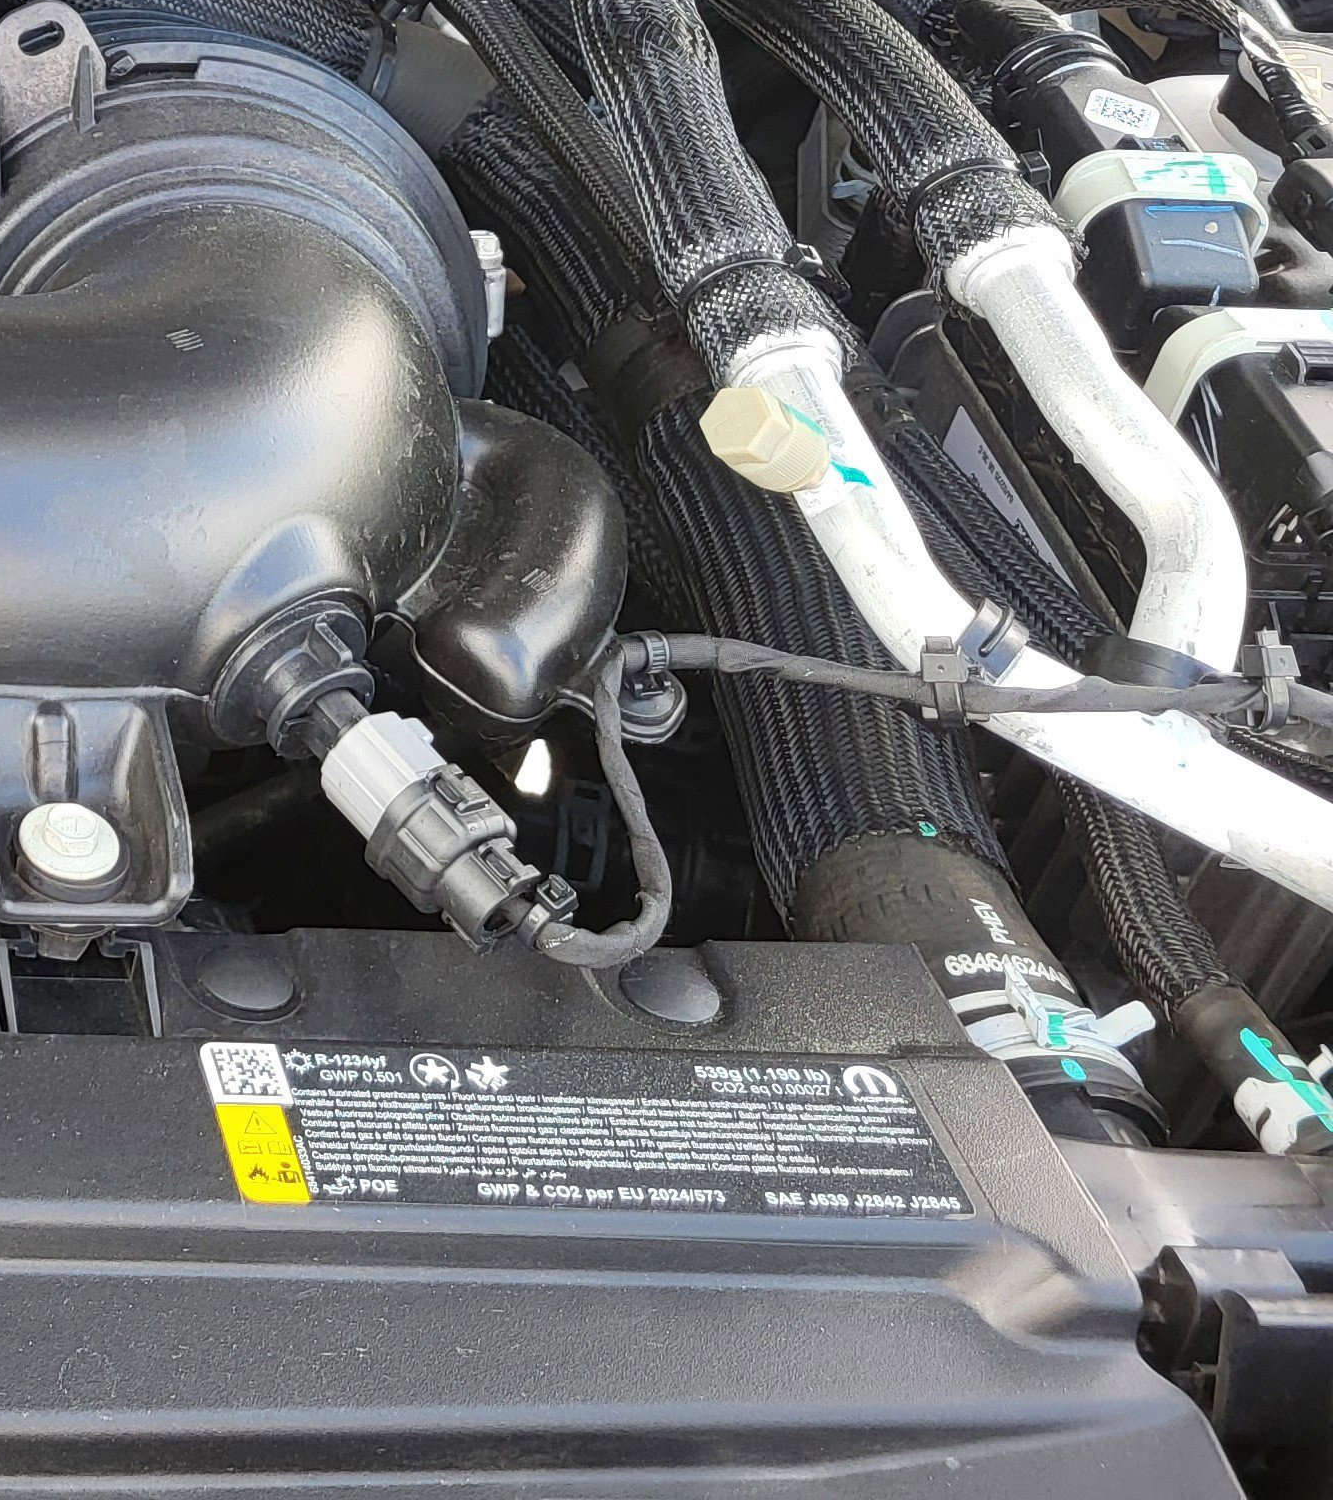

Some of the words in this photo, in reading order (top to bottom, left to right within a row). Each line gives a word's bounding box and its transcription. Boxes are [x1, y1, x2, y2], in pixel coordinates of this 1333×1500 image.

[968, 897, 1016, 946] PHEV
[315, 1053, 387, 1069] R-1234yf
[319, 1069, 358, 1082] GWP
[362, 1071, 403, 1084] 0.501
[693, 1065, 743, 1082] 539g
[804, 1068, 831, 1083] lb)
[711, 1081, 748, 1094] CO2
[750, 1085, 770, 1098] eq
[772, 1083, 831, 1097] 0.00027
[359, 1178, 399, 1193] POE
[477, 1182, 521, 1197] GWP
[525, 1183, 541, 1198] &
[542, 1184, 583, 1199] CO2
[584, 1187, 616, 1202] per
[617, 1186, 646, 1200] EU
[648, 1187, 727, 1204] 2024/573
[764, 1191, 806, 1206] SAE
[808, 1192, 850, 1207] J639
[854, 1193, 907, 1208] J2842
[909, 1195, 962, 1210] J2845
